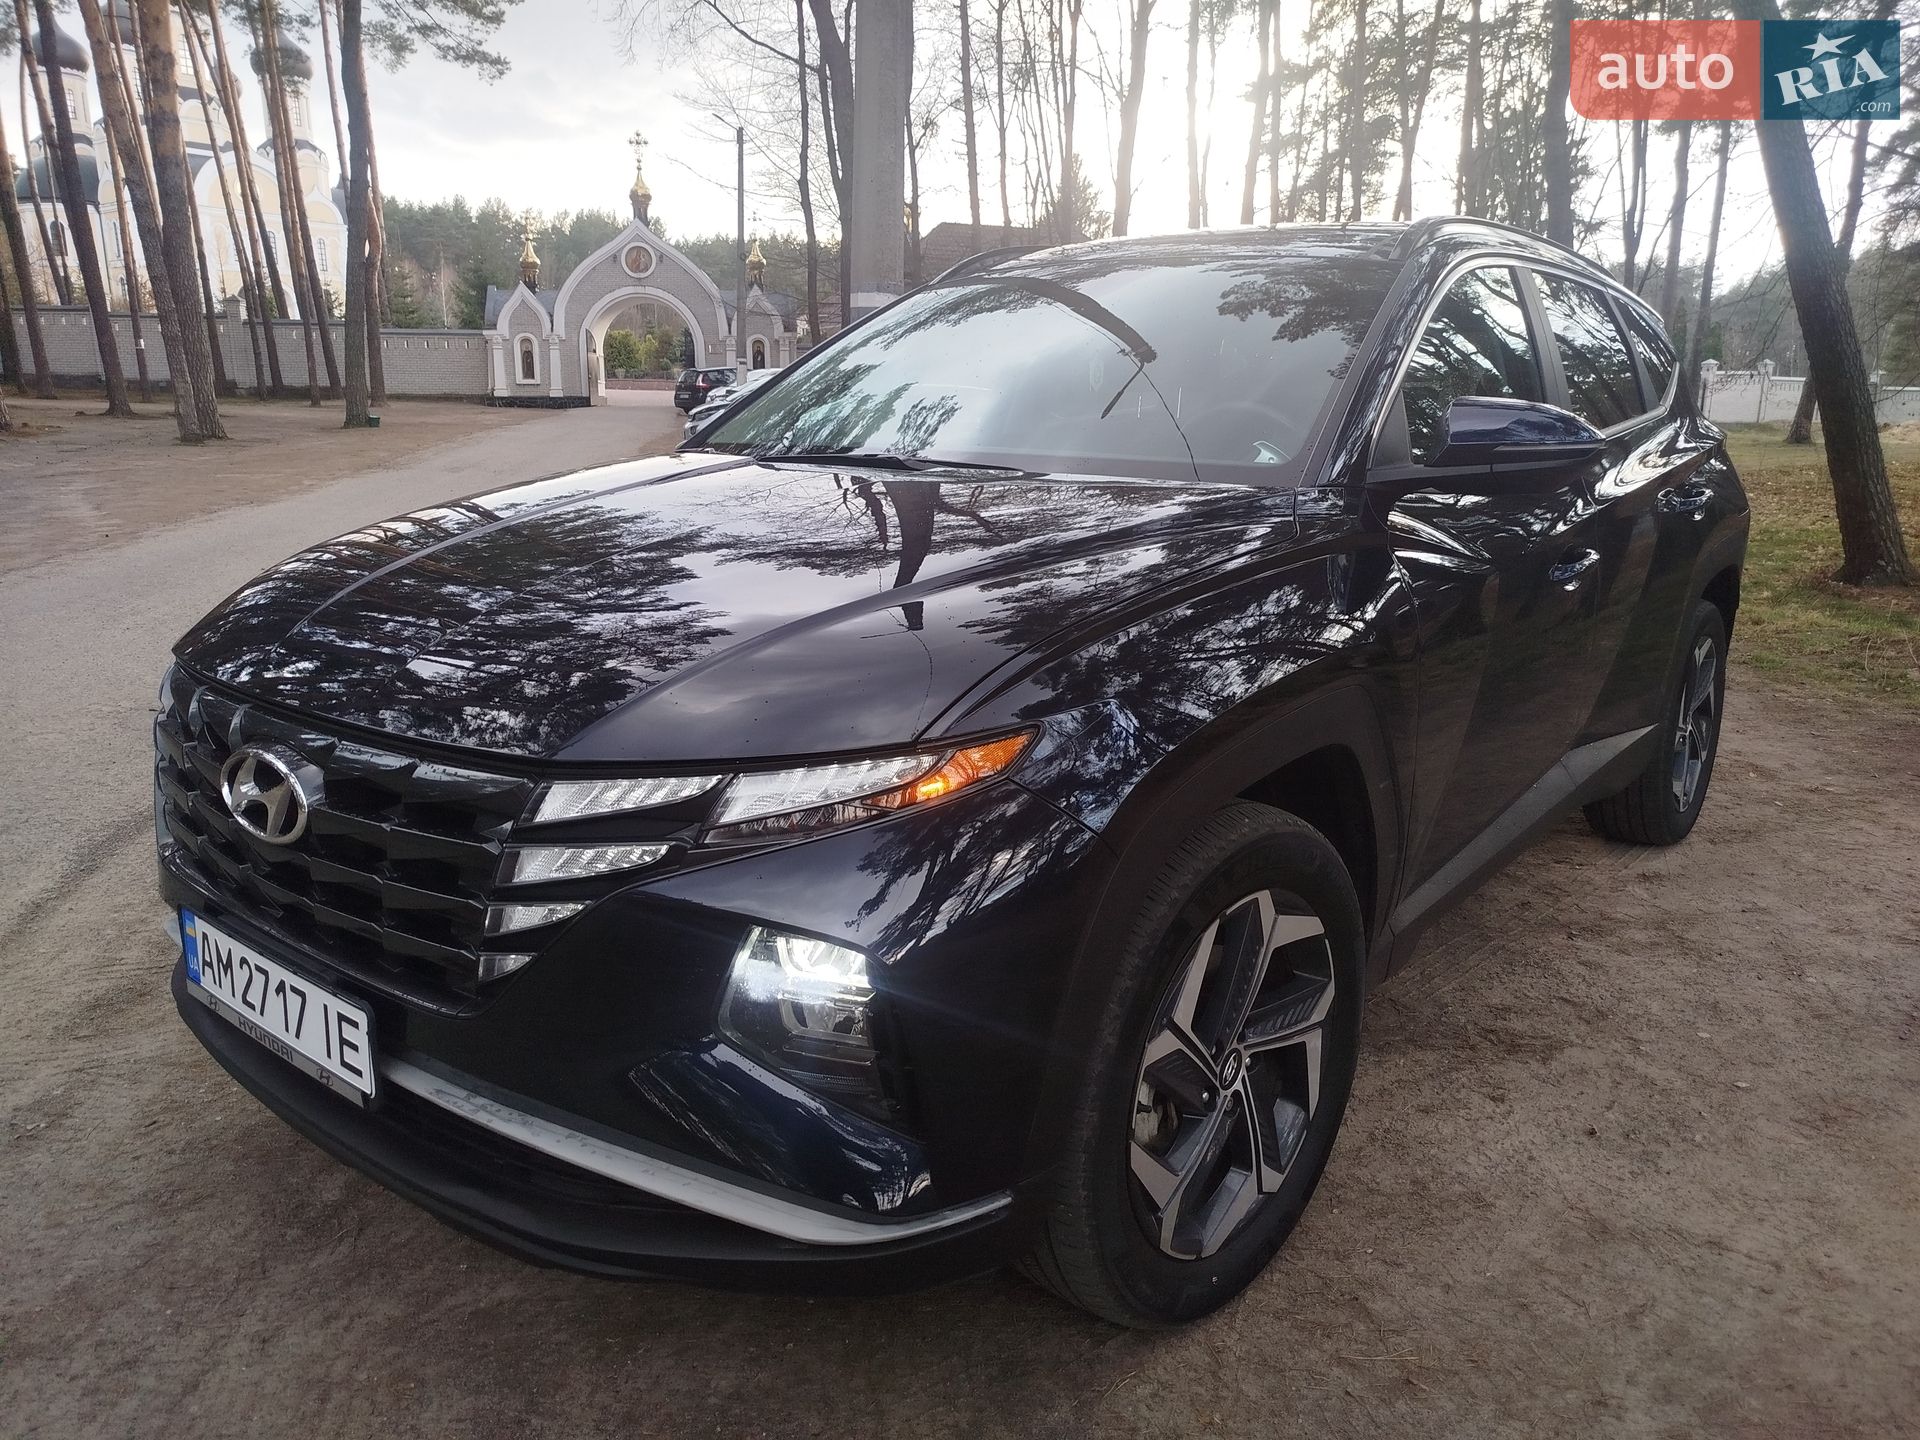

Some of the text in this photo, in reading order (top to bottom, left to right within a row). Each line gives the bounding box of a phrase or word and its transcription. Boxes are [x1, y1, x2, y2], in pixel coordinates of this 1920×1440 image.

[188, 953, 200, 974] UA
[201, 930, 364, 1079] AM 2717 IE
[237, 1016, 294, 1063] HYUNDAI
